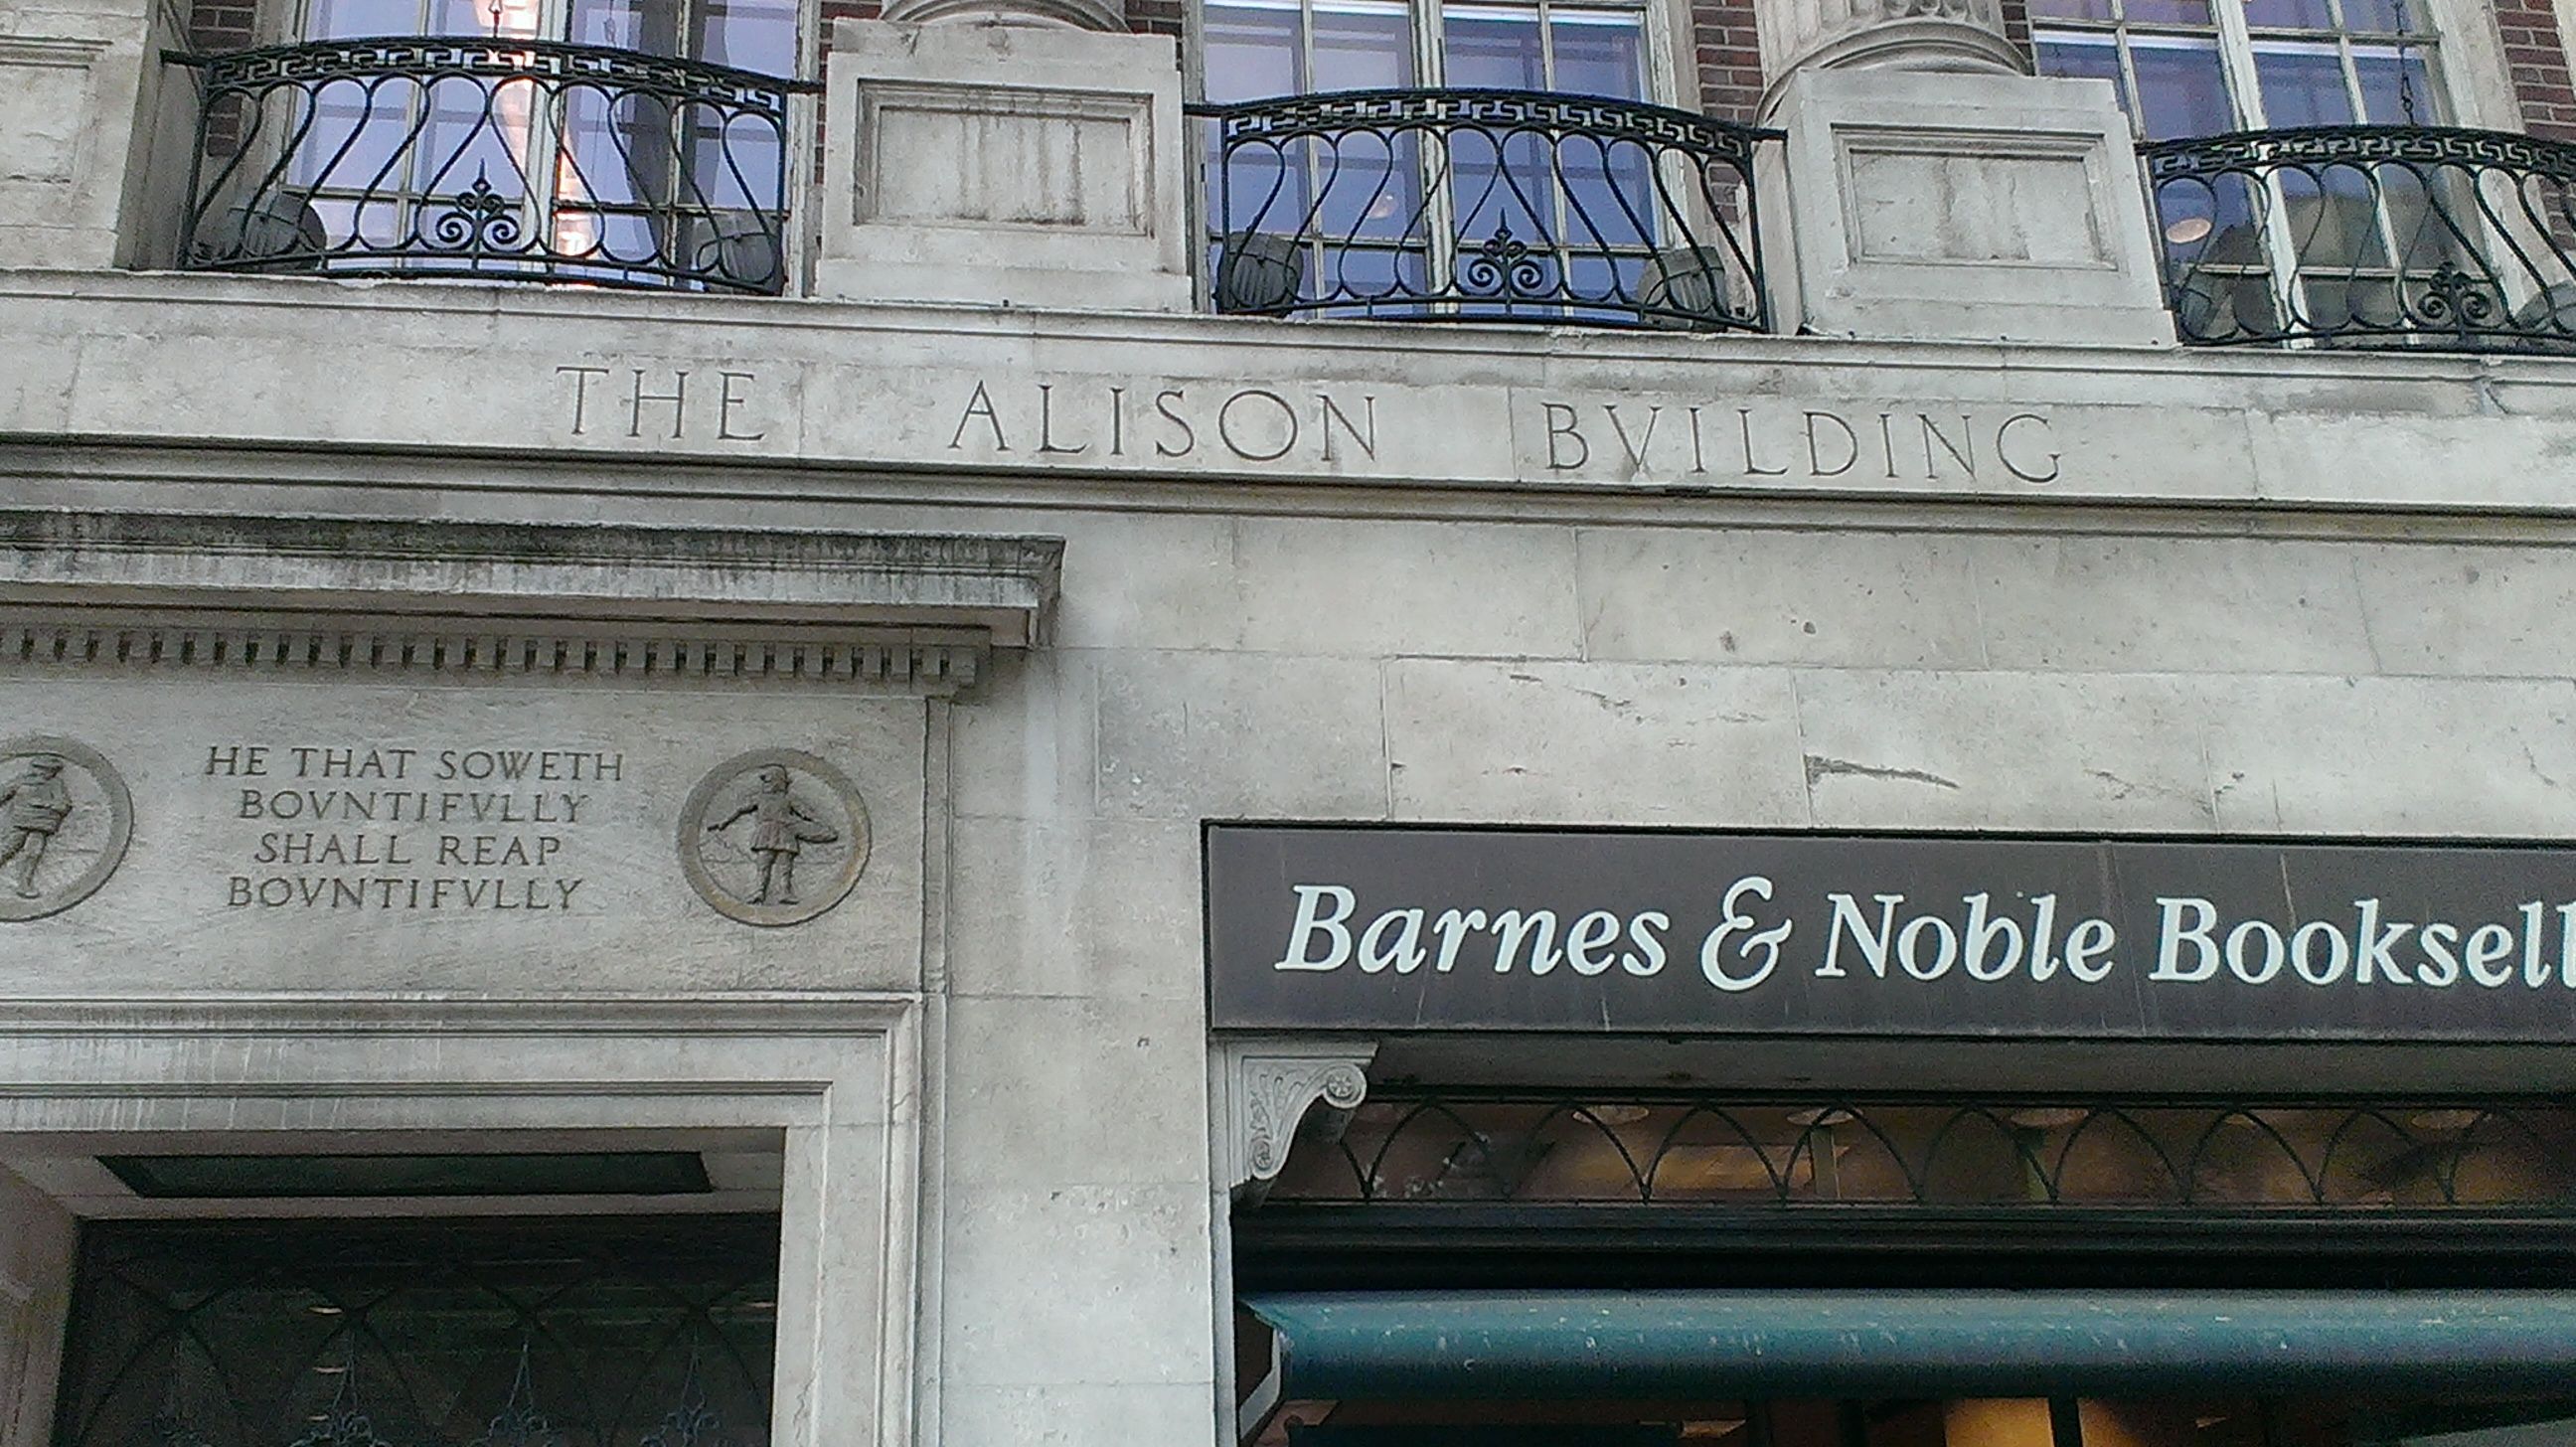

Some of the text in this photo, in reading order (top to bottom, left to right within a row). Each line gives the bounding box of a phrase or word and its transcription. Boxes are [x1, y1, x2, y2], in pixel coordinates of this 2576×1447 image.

[556, 366, 2061, 484] THE ALISON BVILDING
[205, 745, 624, 782] HE THAT SOWETH
[239, 788, 590, 823] BOVNTIFVLLY
[253, 832, 562, 867] SHALL REAP
[227, 876, 583, 909] BOVNTIFVLLY
[1274, 876, 2576, 991] Barnes & Noble Booksell
